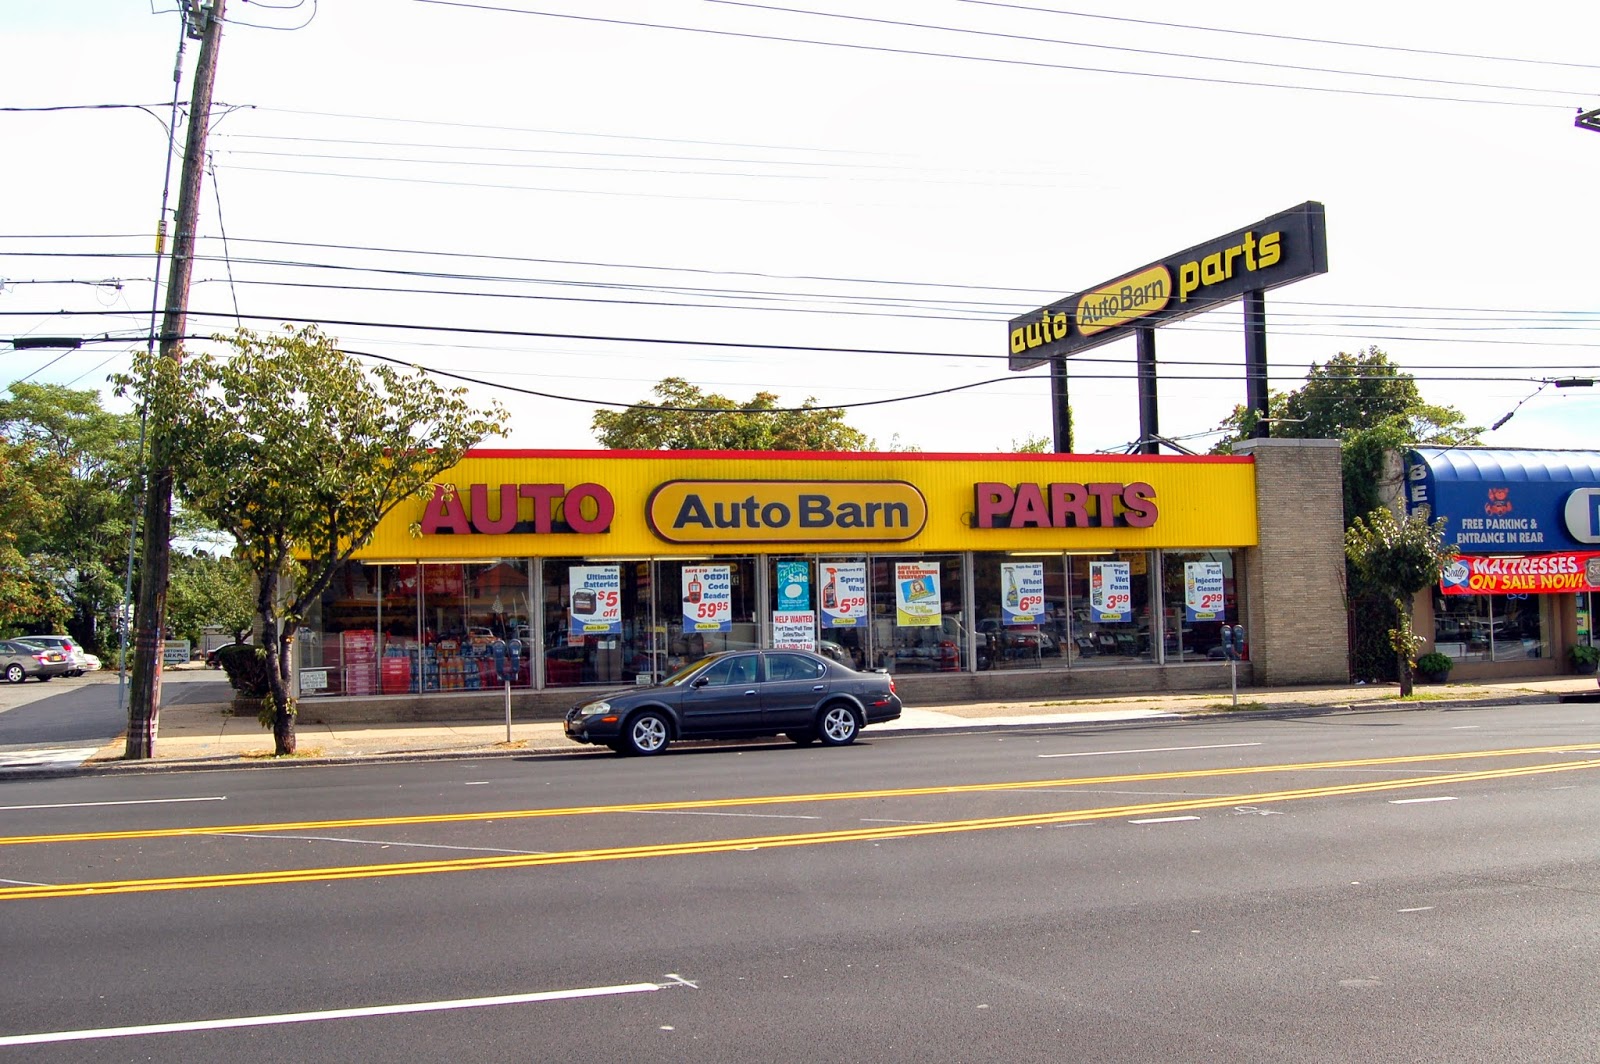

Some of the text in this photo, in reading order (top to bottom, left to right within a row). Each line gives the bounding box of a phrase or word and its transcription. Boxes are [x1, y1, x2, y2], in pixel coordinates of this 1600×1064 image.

[1010, 310, 1068, 354] auto
[1179, 231, 1281, 303] parts
[420, 482, 615, 534] AUTO
[976, 482, 1159, 529] PARTS
[1462, 518, 1538, 530] FREE PARKING &
[1456, 531, 1544, 544] ENTRANCE IN REAR
[1473, 556, 1578, 575] MATTRESSES
[788, 573, 808, 582] Sale
[840, 576, 865, 584] Spray
[1469, 573, 1583, 590] ON SALE NOW!
[602, 608, 618, 618] off
[789, 615, 813, 623] WANTED
